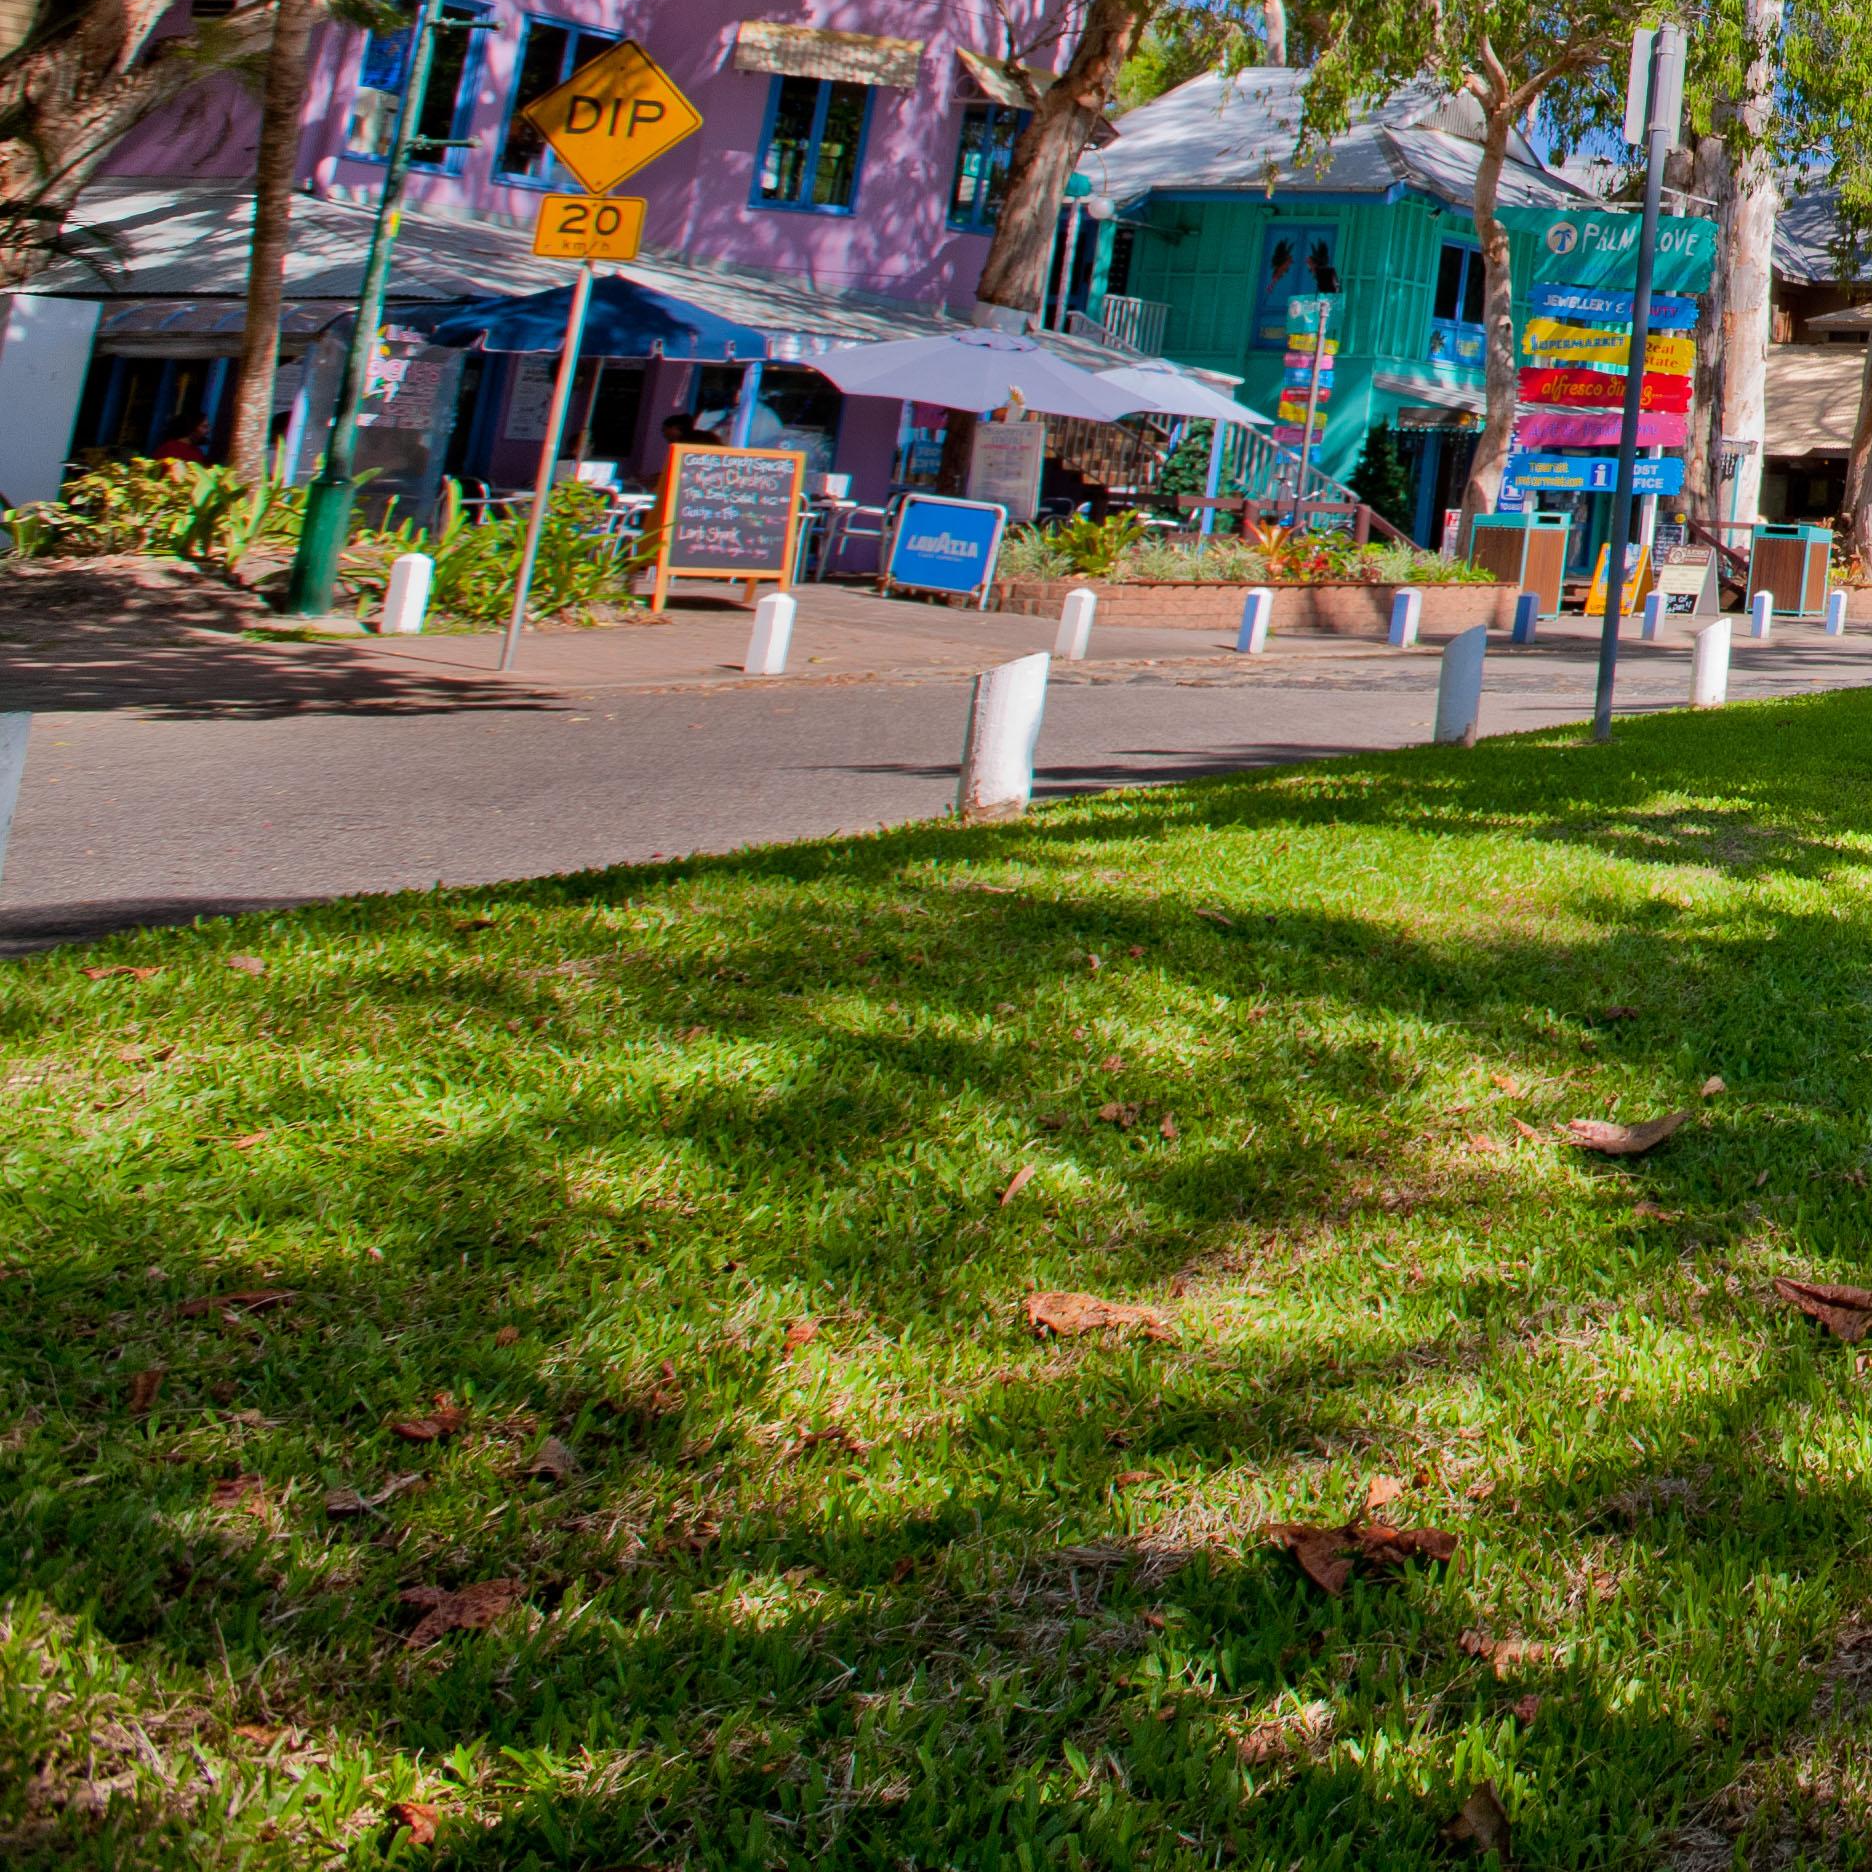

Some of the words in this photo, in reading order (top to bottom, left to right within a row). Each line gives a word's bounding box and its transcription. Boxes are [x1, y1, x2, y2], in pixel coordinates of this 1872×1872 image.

[564, 95, 666, 137] DIP
[557, 204, 621, 235] 20
[560, 239, 611, 252] km/h
[1582, 223, 1637, 253] PALM
[1543, 294, 1611, 313] JEWELLERY
[1542, 375, 1603, 401] alfresco
[906, 532, 979, 559] LAVAZZA
